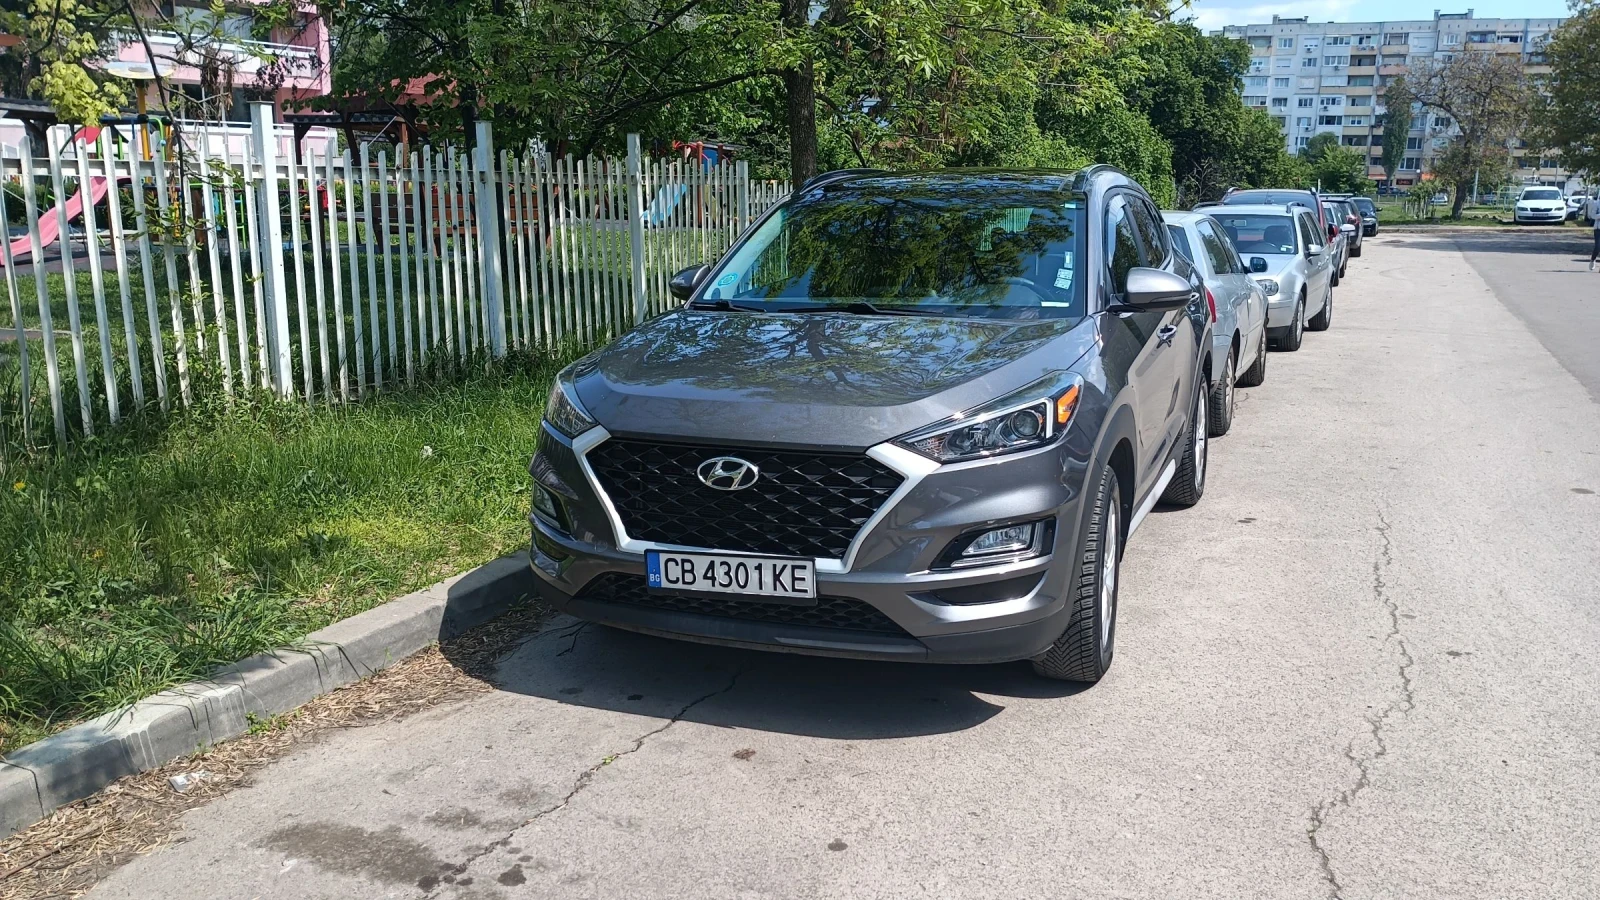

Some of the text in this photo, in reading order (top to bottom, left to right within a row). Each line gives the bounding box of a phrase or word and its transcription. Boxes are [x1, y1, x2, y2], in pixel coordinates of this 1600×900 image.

[650, 573, 660, 582] BG
[664, 558, 809, 594] CB 4301 KE
